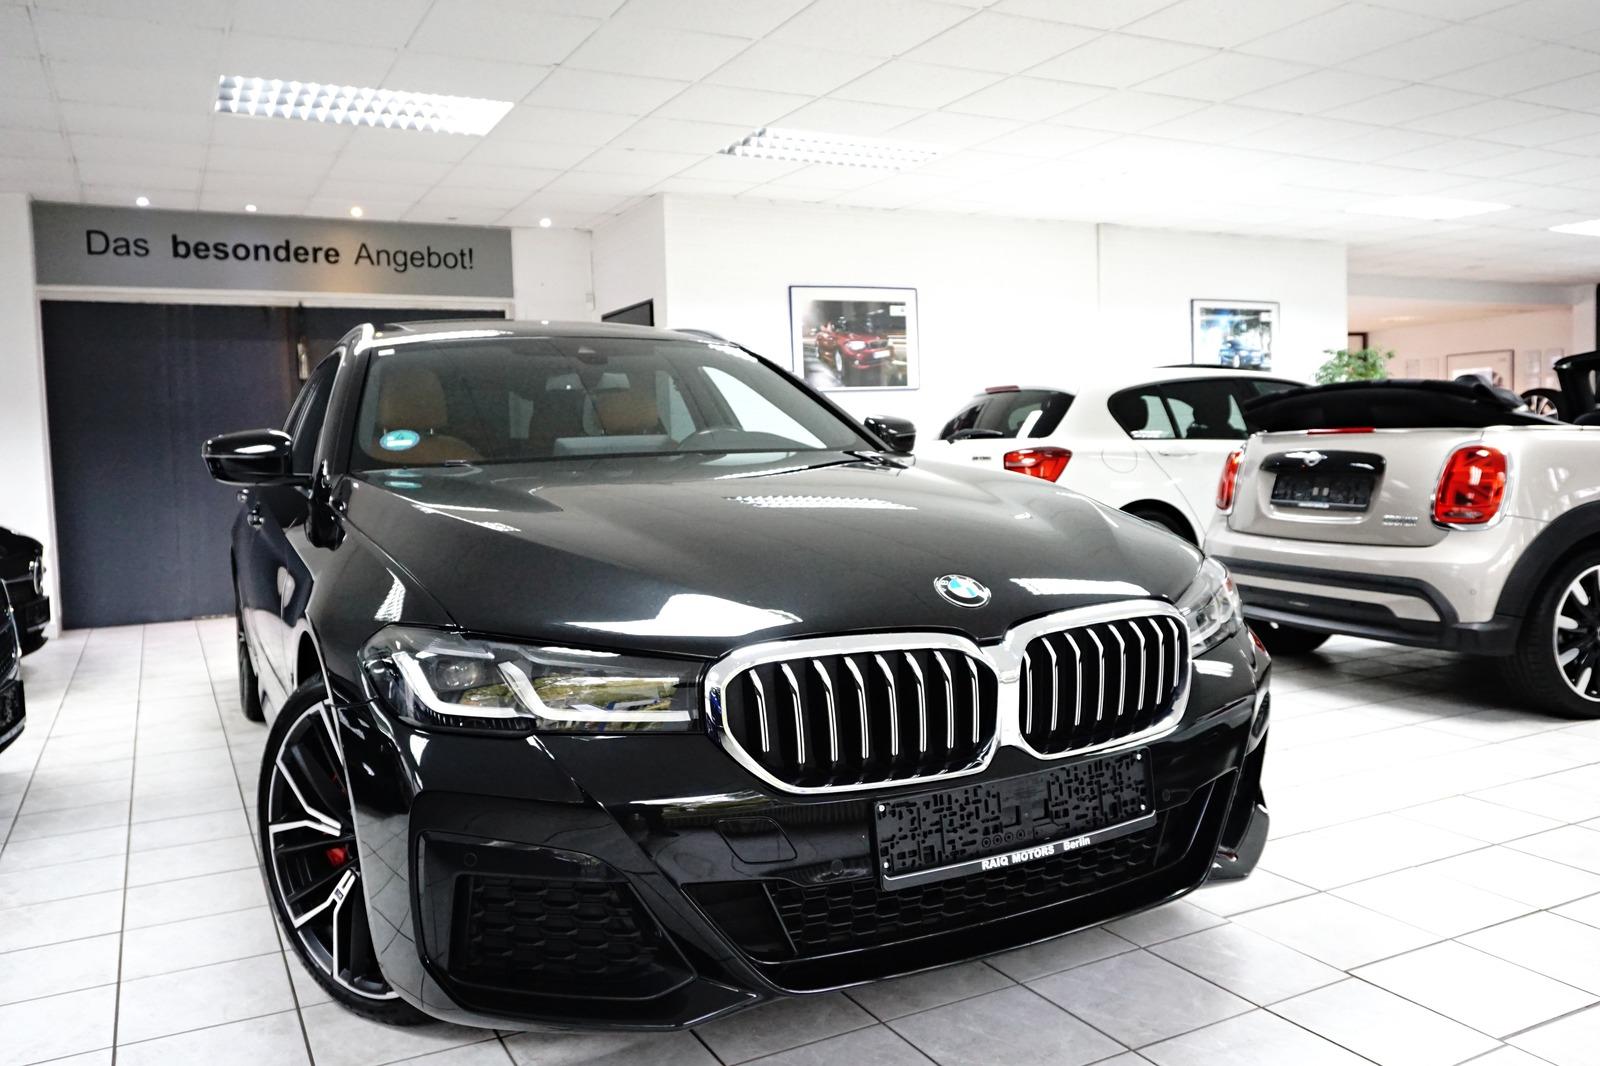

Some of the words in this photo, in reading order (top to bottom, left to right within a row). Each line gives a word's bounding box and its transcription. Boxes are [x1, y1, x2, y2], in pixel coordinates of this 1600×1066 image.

[86, 229, 150, 257] Das
[171, 234, 340, 264] besondere
[354, 242, 474, 273] Angebot!
[981, 856, 1009, 870] RAIQ
[1011, 845, 1055, 864] MOTORS
[1063, 837, 1091, 851] Berlin
